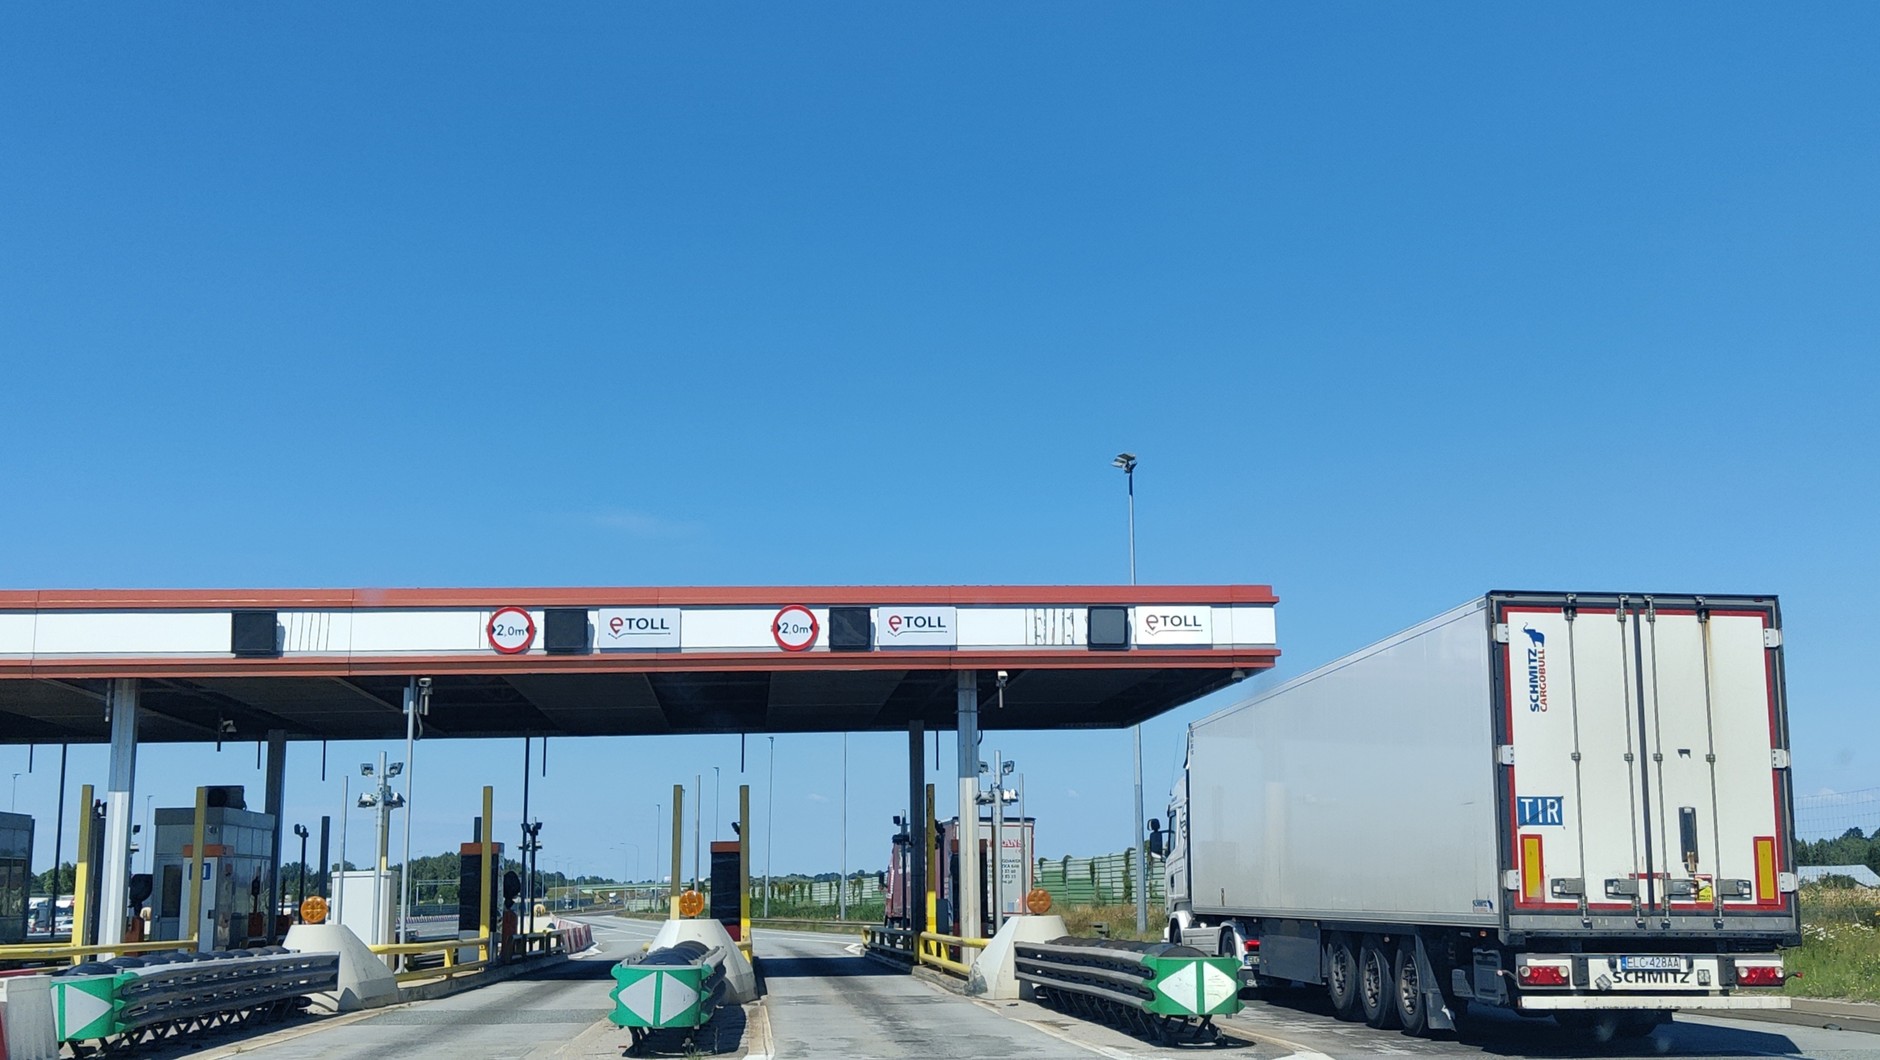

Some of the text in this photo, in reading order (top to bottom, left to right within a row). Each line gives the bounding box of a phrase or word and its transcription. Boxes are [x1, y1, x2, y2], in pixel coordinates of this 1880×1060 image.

[609, 617, 670, 635] eTOLL
[888, 615, 946, 632] eTOLL
[1146, 614, 1202, 630] eTOLL
[1528, 648, 1539, 712] SCHMITZ
[1538, 649, 1548, 712] CARGOBULL
[1520, 799, 1559, 823] TIR
[1612, 972, 1690, 984] SCHMITZ
